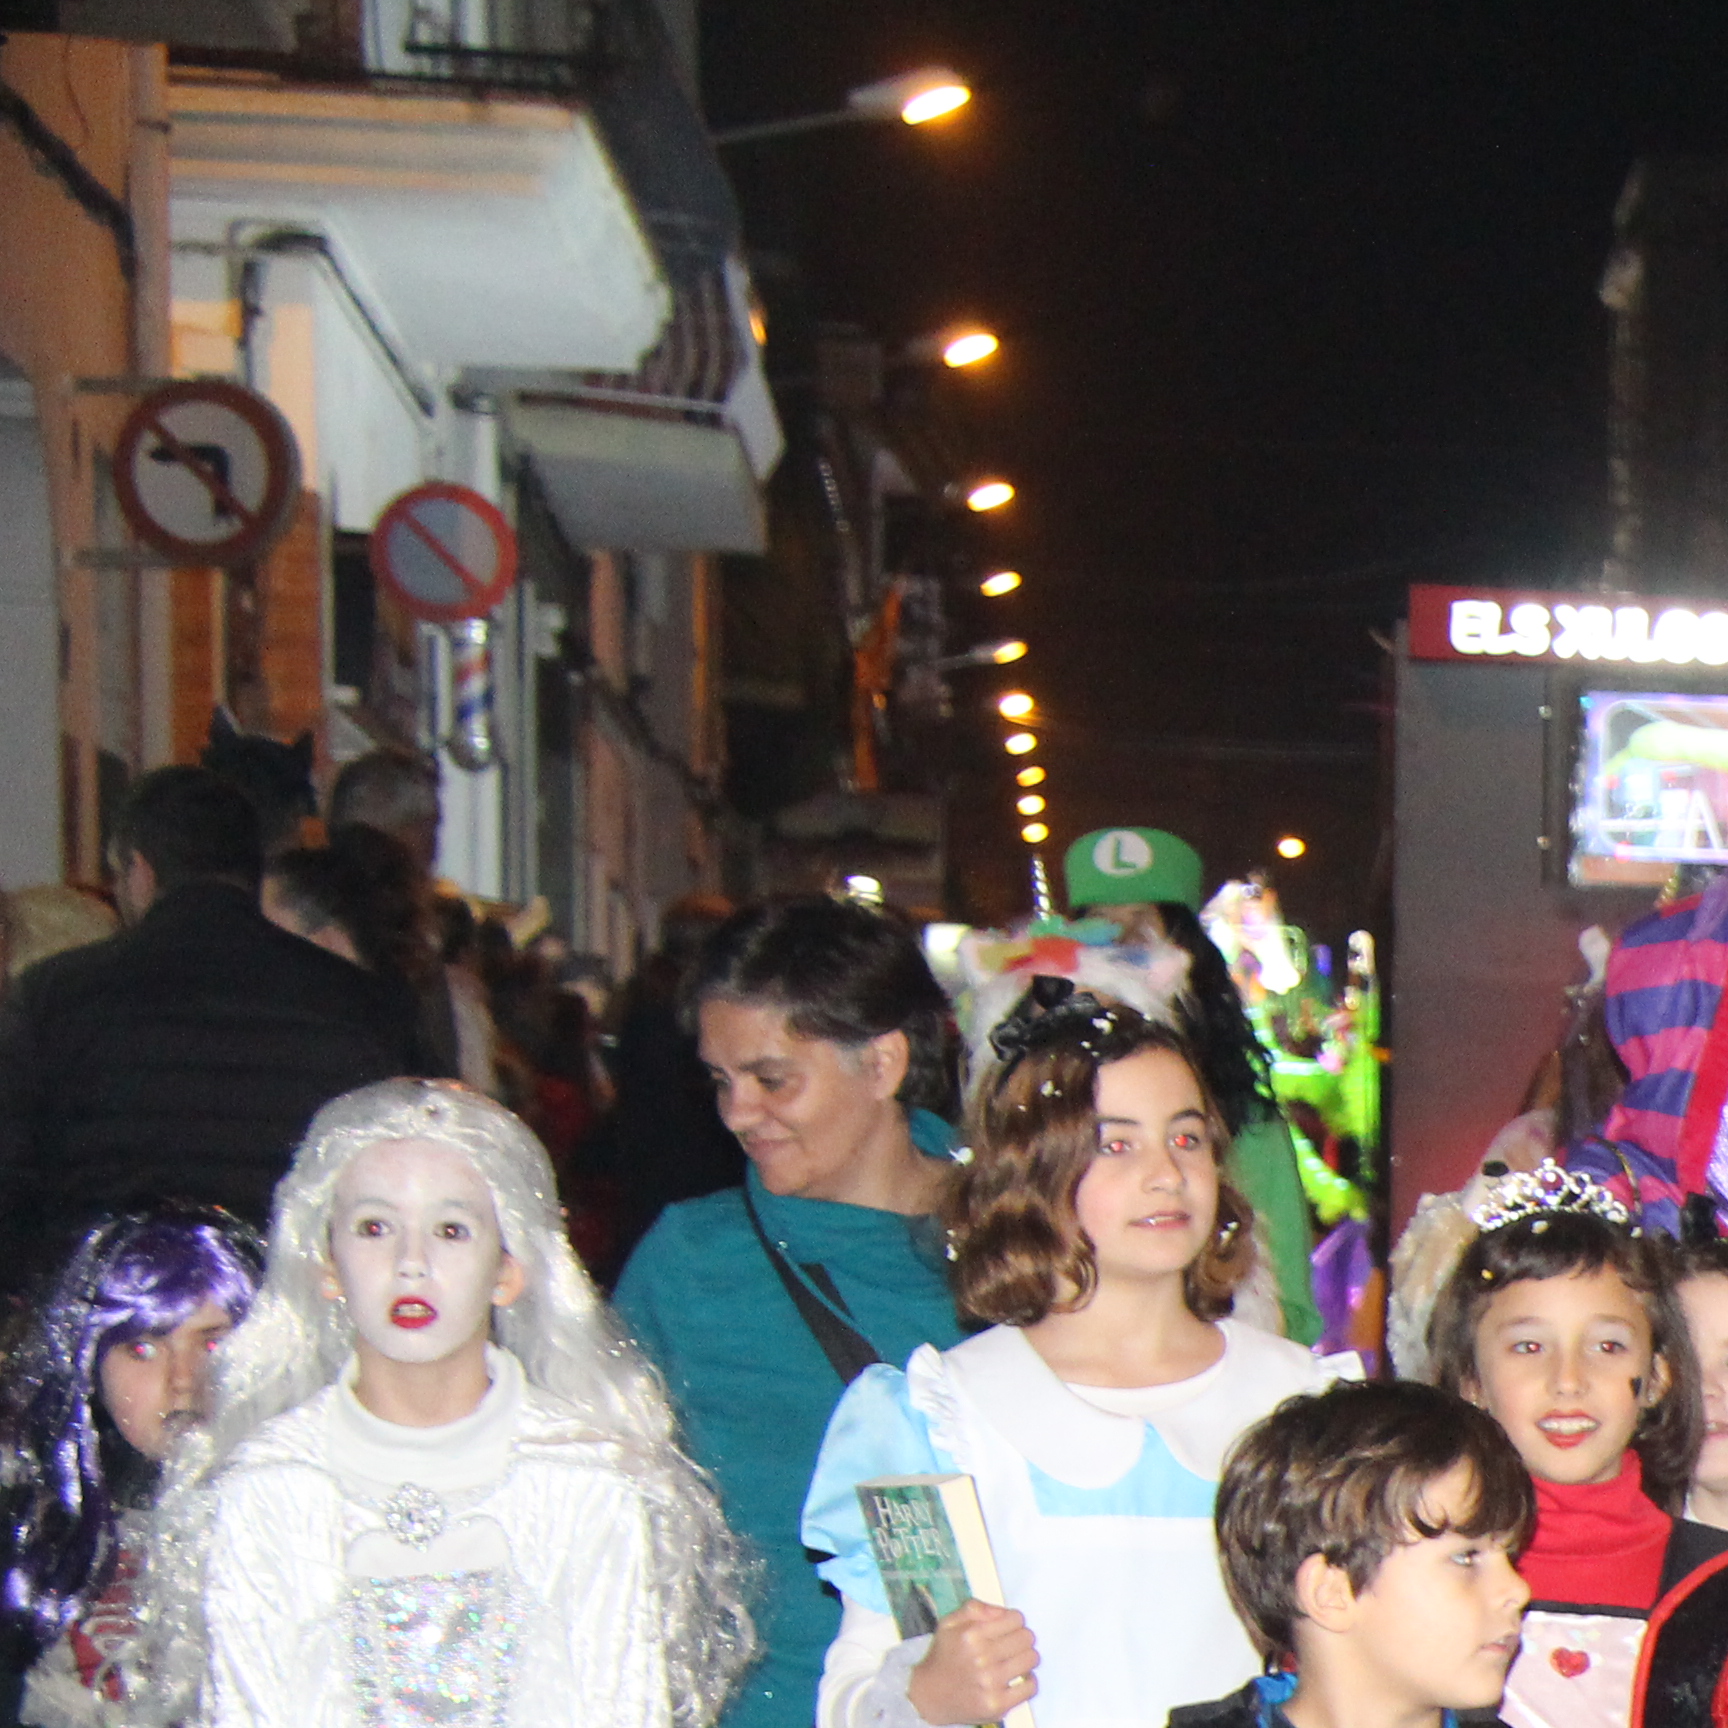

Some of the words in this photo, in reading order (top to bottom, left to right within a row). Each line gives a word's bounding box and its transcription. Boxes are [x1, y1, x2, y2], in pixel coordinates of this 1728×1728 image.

[1450, 599, 1551, 656] ELS
[1113, 839, 1137, 868] L
[872, 1495, 935, 1529] HARRY
[874, 1526, 951, 1563] POTTER
